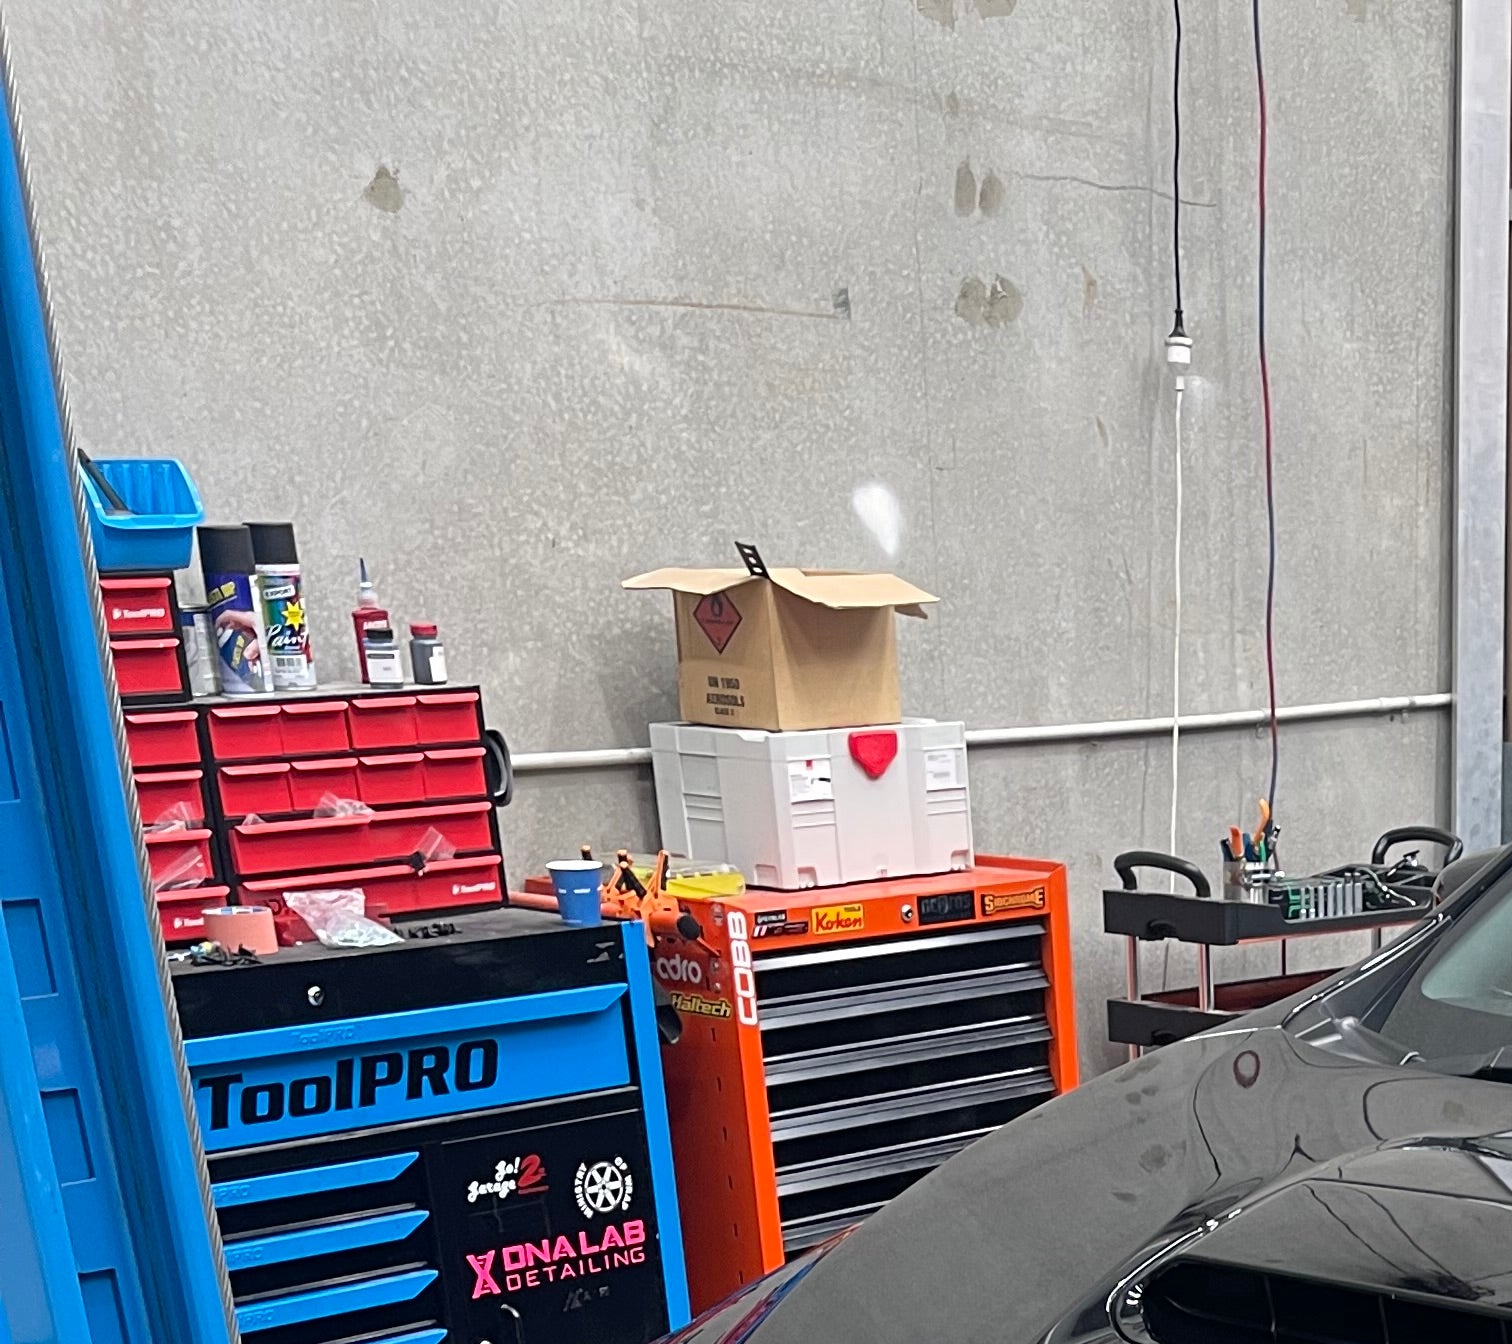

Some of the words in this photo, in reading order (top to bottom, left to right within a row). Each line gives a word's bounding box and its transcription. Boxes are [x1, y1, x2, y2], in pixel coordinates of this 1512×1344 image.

[266, 624, 309, 647] Paint
[815, 909, 863, 932] Koken
[656, 953, 702, 984] adro
[727, 911, 759, 1026] COBB
[671, 994, 732, 1018] Haltech
[198, 1038, 499, 1131] ToolPRO
[506, 1246, 646, 1292] DETAILING
